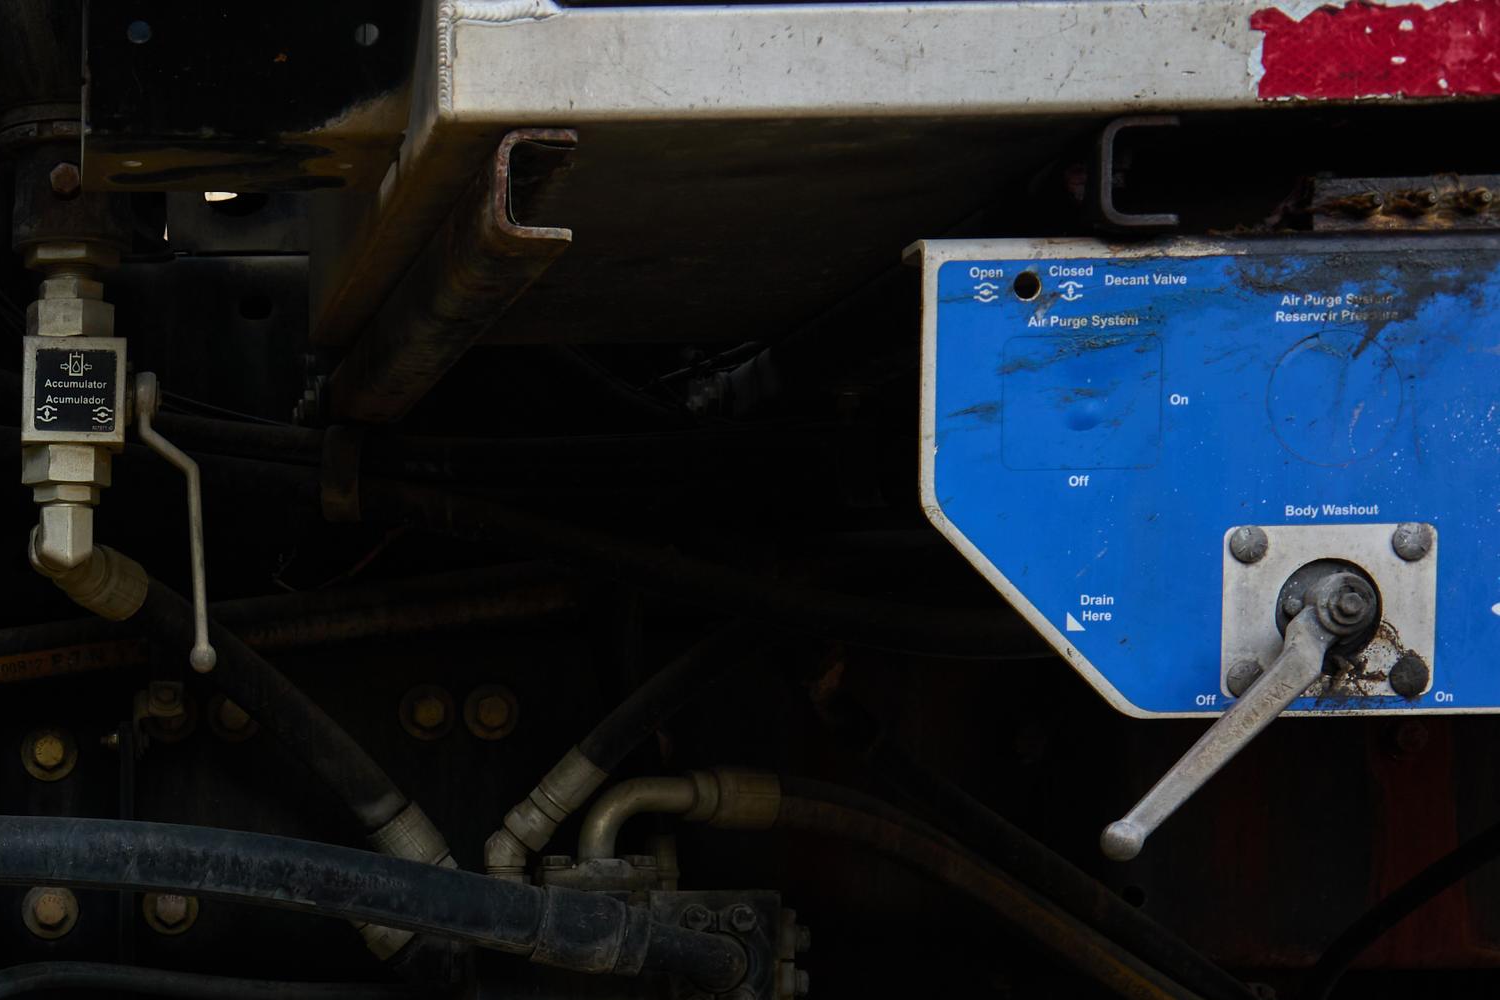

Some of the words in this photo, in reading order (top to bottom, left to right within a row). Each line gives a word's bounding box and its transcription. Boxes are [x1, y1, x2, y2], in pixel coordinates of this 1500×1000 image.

[969, 267, 1004, 280] Open
[1049, 265, 1094, 278] Closed
[1104, 274, 1149, 286] Decant
[1152, 273, 1188, 285] Valve
[1281, 294, 1301, 306] Air
[1303, 293, 1343, 307] Purge
[1027, 316, 1046, 328] Air
[1047, 316, 1087, 330] Purge
[1090, 314, 1139, 329] System
[44, 378, 108, 390] Accumulator
[45, 394, 106, 406] Acumulador
[1170, 393, 1189, 406] On
[1068, 474, 1089, 488] Off
[1284, 504, 1319, 518] Body
[1322, 503, 1379, 517] Washout
[1080, 593, 1115, 607] Drain
[1081, 609, 1112, 622] Here
[1195, 694, 1217, 706] Off
[1435, 691, 1454, 704] On
